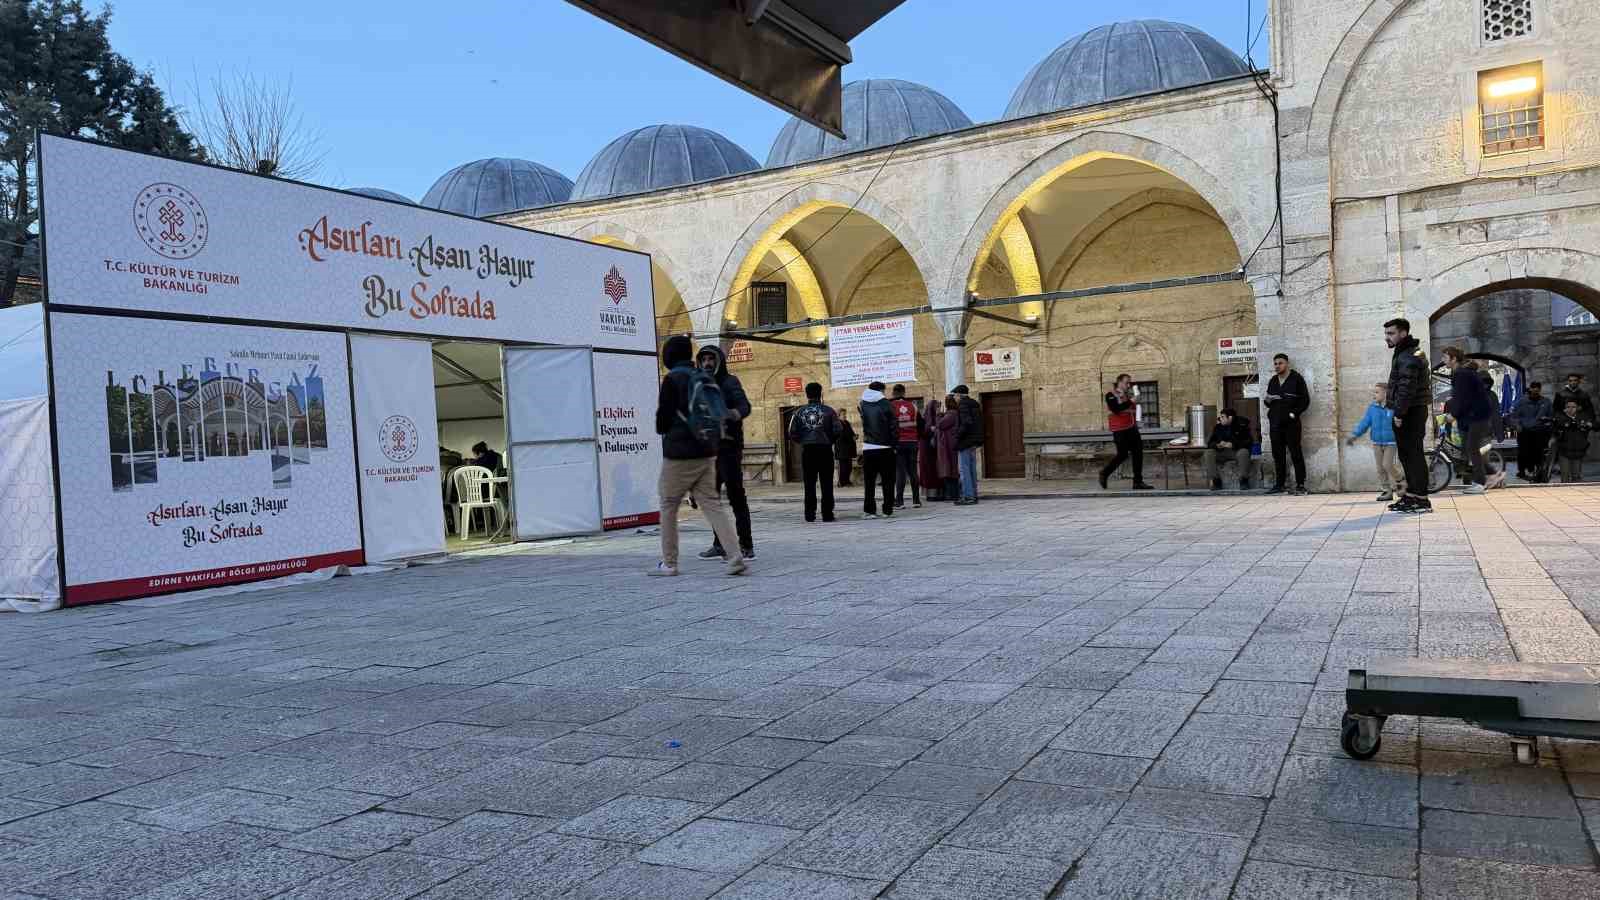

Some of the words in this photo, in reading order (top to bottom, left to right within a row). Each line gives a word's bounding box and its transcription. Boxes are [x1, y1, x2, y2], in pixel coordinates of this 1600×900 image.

[298, 215, 403, 262] Asırları
[409, 234, 473, 278] Aşan
[476, 243, 537, 288] Hayır
[104, 259, 127, 273] T.C.
[129, 261, 177, 279] KÜLTÜR
[179, 268, 194, 280] VE
[198, 271, 240, 285] TURİZM
[143, 277, 208, 295] BAKANLIĞI
[362, 273, 405, 319] Bu
[409, 281, 497, 321] Sofrada
[599, 312, 636, 327] VAKIFLAR
[603, 407, 635, 421] Elçileri
[600, 424, 638, 439] Boyunca
[604, 440, 649, 454] Buluşuyor
[147, 501, 207, 527] Asırları
[209, 497, 248, 522] Aşan
[251, 496, 289, 517] Hayır
[182, 525, 206, 548] Bu
[209, 521, 264, 544] Sofrada
[148, 576, 183, 587] EDİRNE
[184, 570, 227, 583] VAKIFLAR
[229, 567, 256, 578] BÖLGE
[258, 558, 308, 573] MÜDÜRLÜĞÜ
